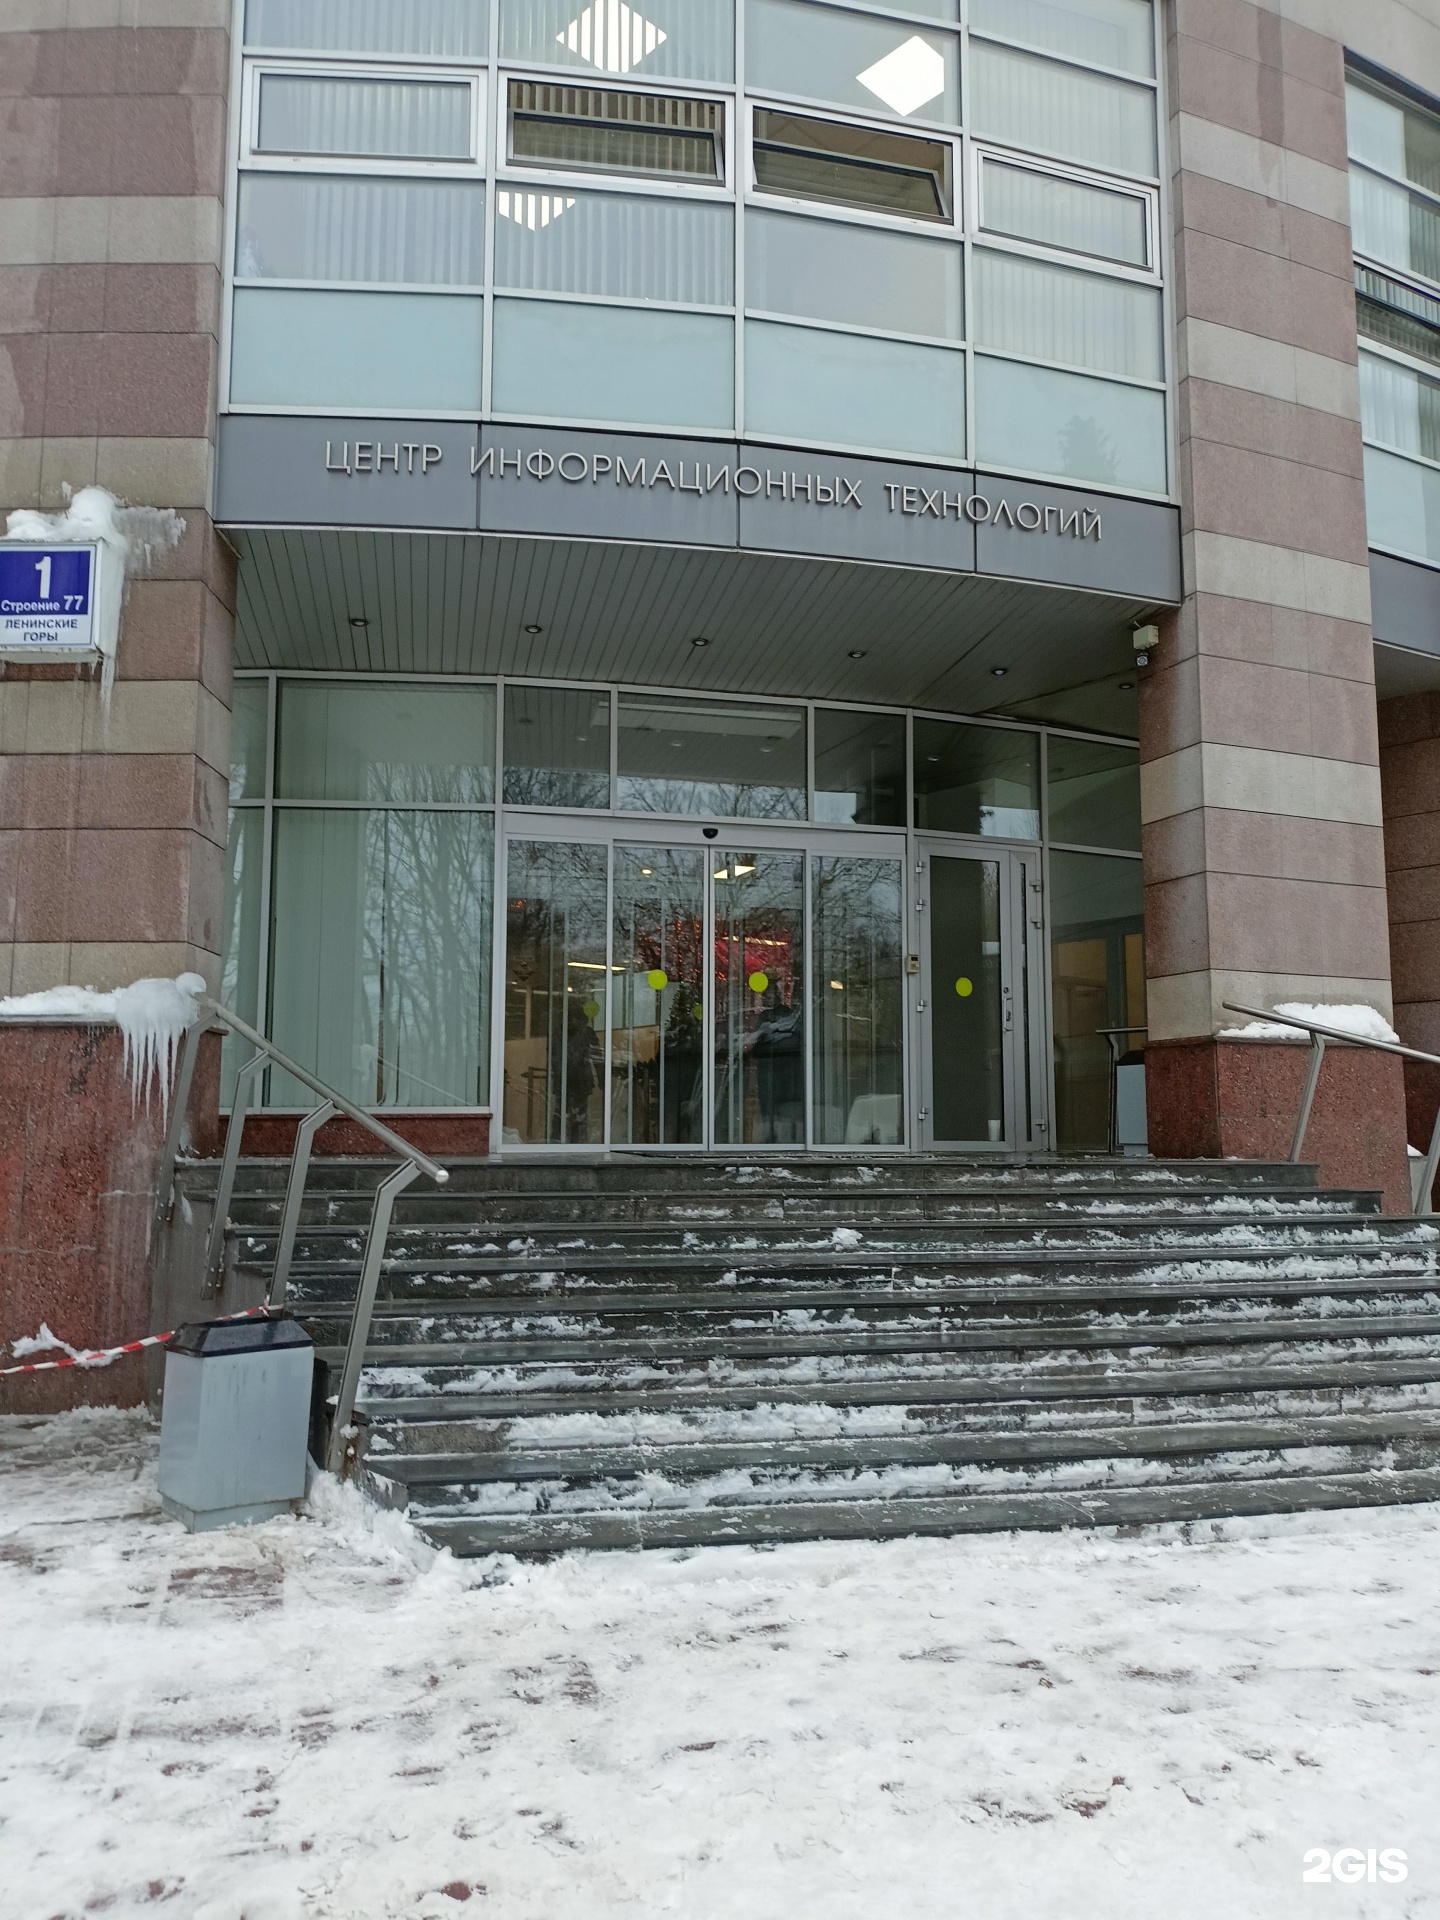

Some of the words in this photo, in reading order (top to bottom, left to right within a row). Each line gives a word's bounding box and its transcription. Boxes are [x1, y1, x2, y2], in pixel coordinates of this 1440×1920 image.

[326, 440, 443, 476] ЦЕНТР
[470, 446, 863, 508] ИНФОРМАЦИОННЫХ
[885, 483, 1102, 541] ТЕХНОЛОГИЙ
[35, 556, 51, 599] 1
[1, 599, 60, 614] Строение
[63, 595, 84, 611] 77
[5, 619, 78, 629] ЛЕНИНСКИЕ
[23, 632, 58, 642] ГОРЫ
